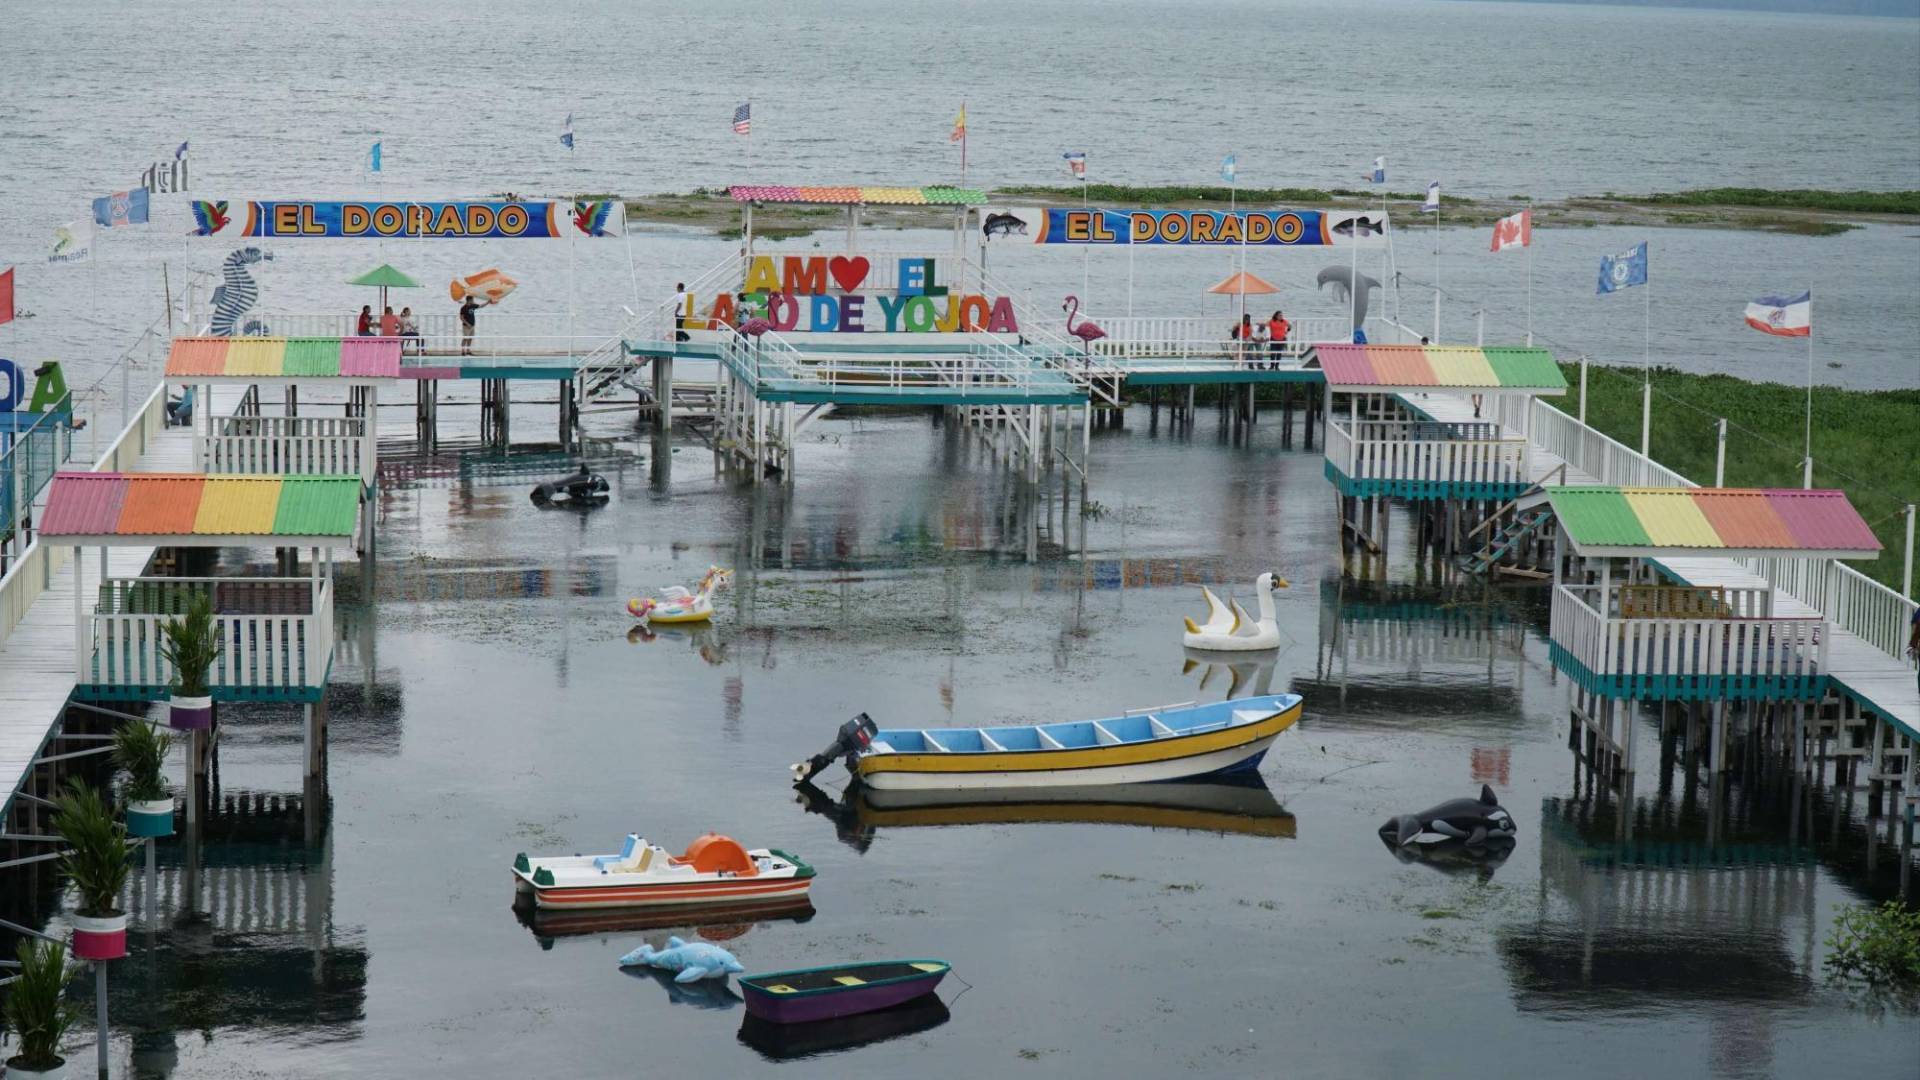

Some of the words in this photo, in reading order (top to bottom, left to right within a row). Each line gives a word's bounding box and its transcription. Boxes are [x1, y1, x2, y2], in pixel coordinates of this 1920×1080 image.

[274, 203, 326, 235] EL
[343, 203, 529, 237] DORADO
[1066, 211, 1115, 241] EL
[1131, 211, 1305, 244] DORADO
[899, 258, 948, 296] EL
[810, 294, 865, 332] DE
[876, 294, 1018, 334] YOJOA
